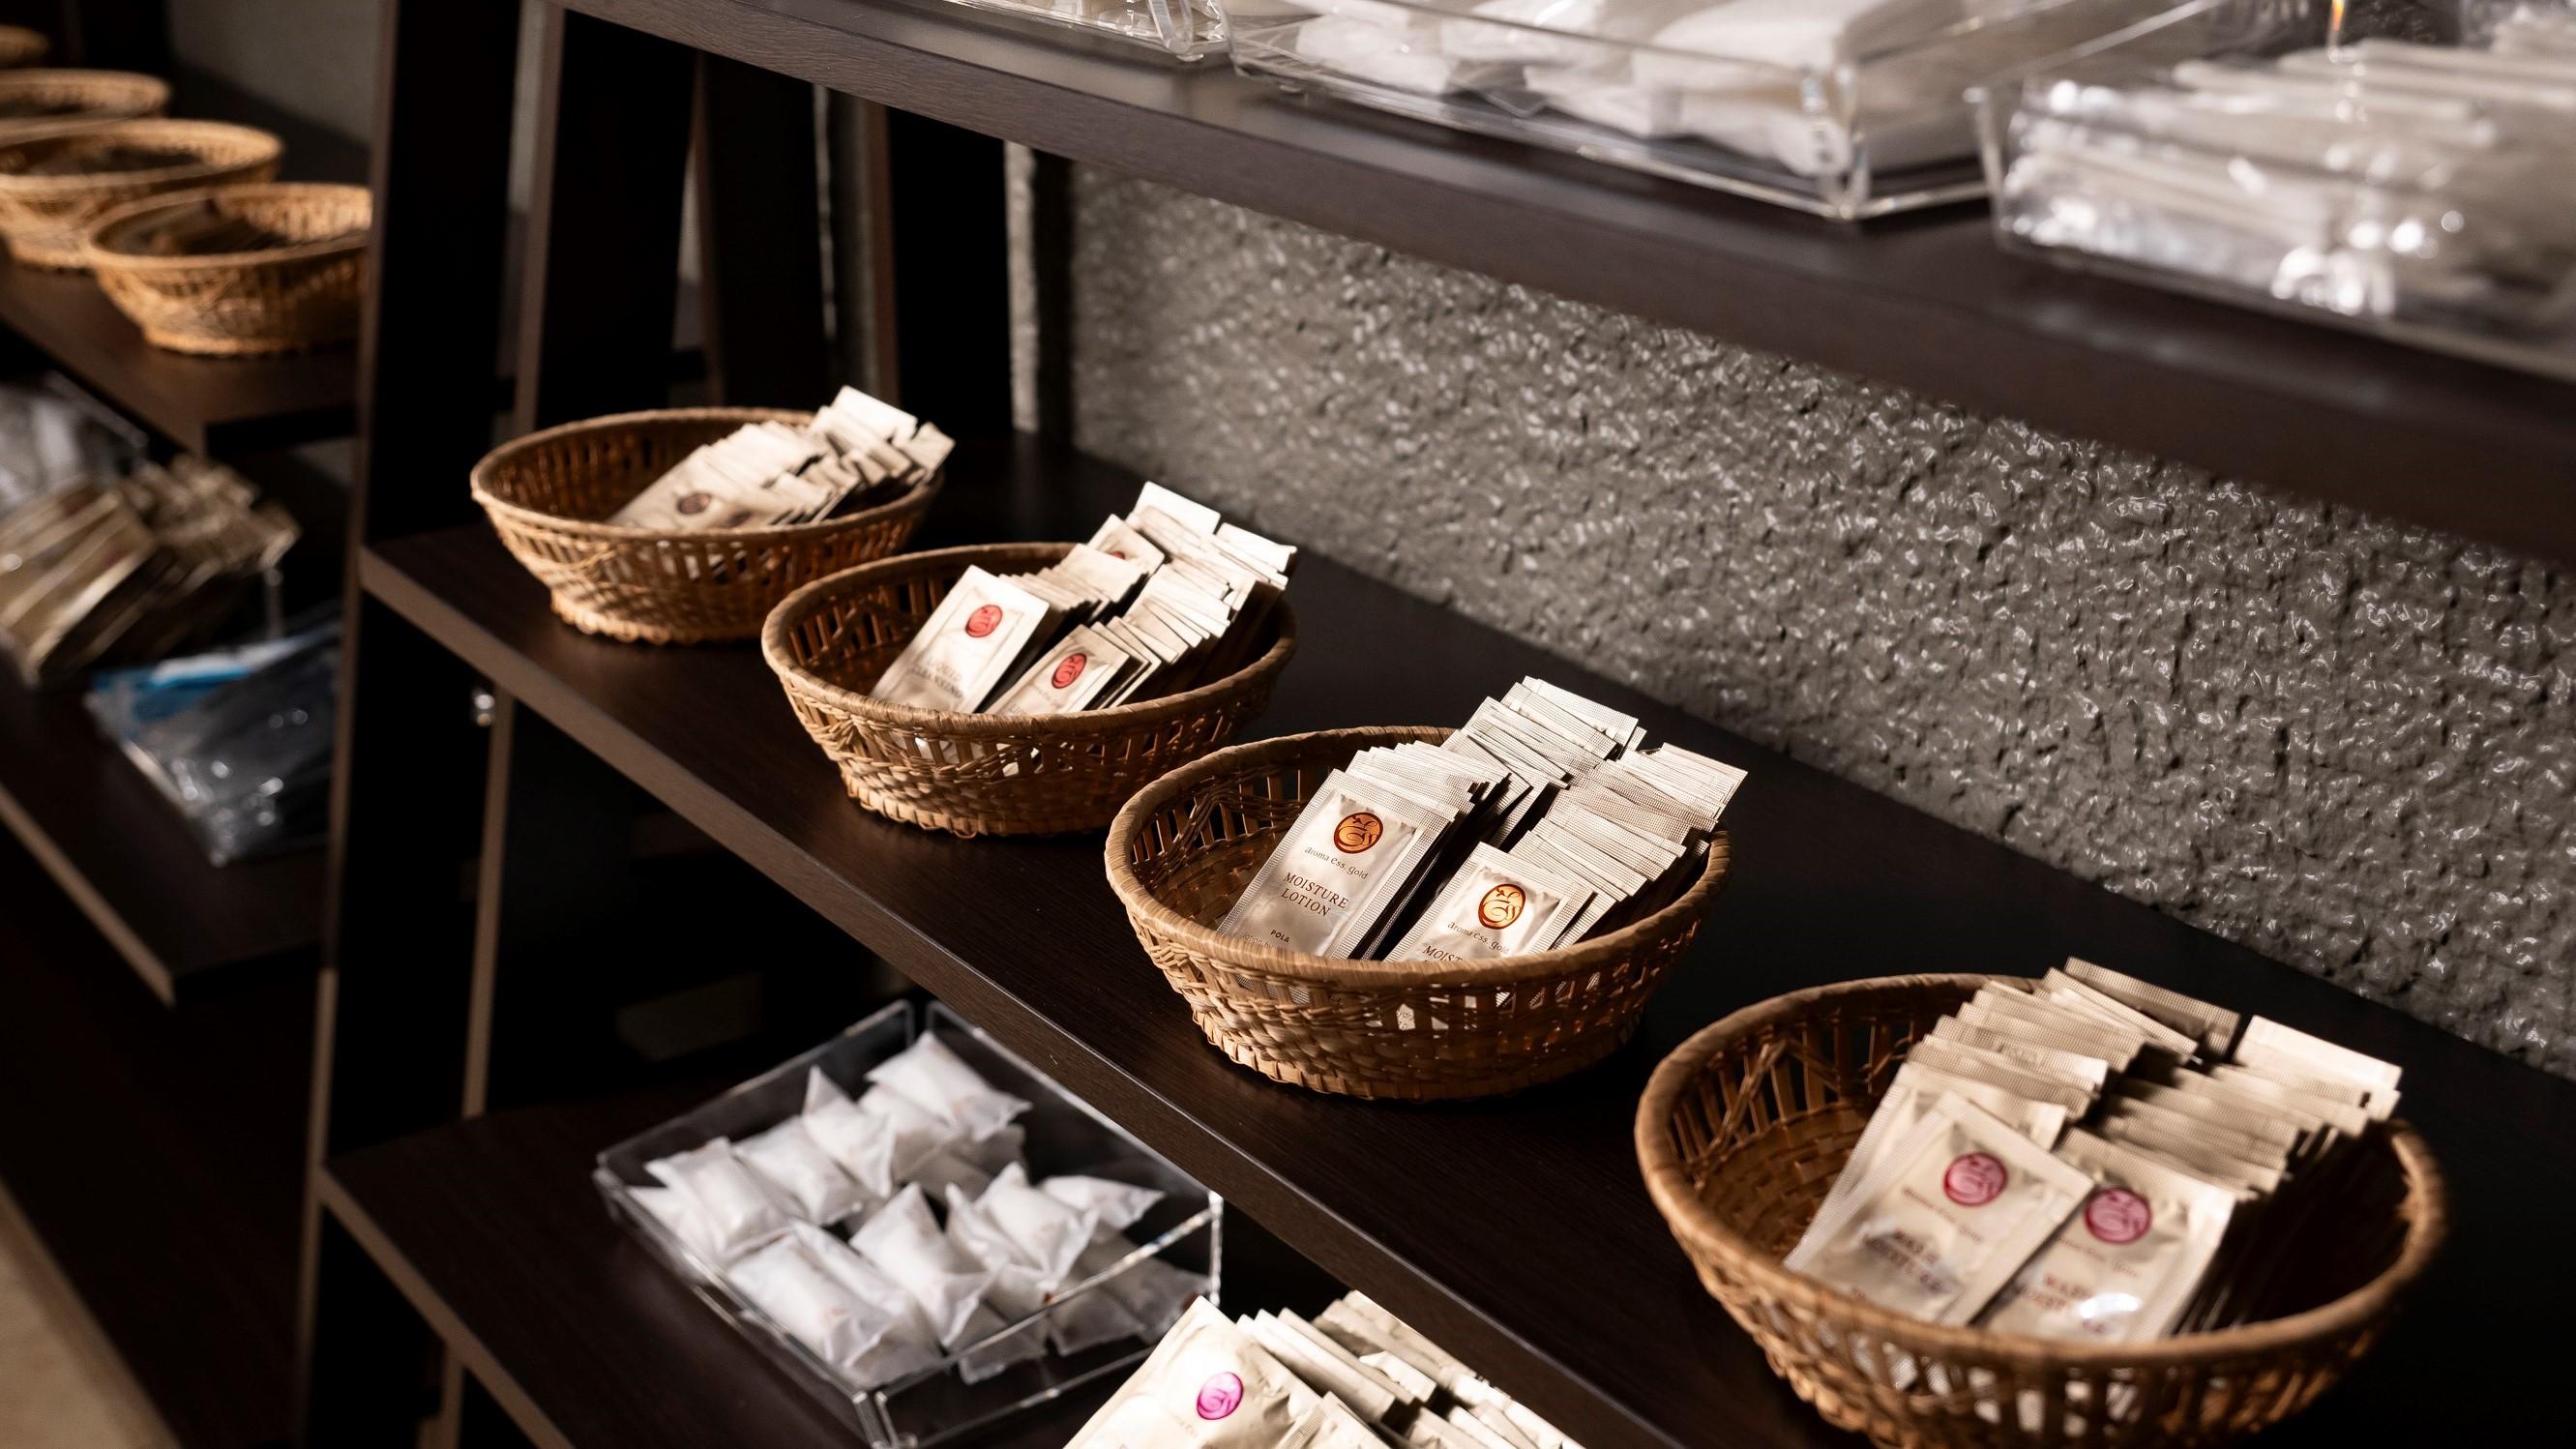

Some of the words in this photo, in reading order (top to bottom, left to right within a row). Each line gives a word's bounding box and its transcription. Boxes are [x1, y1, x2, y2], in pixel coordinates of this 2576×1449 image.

[1305, 846, 1330, 861] aroma
[1347, 866, 1369, 879] gold
[1281, 888, 1331, 916] LOTION
[1283, 872, 1349, 908] MOISTURE
[1270, 930, 1290, 943] POLA
[1447, 921, 1473, 936] aroma
